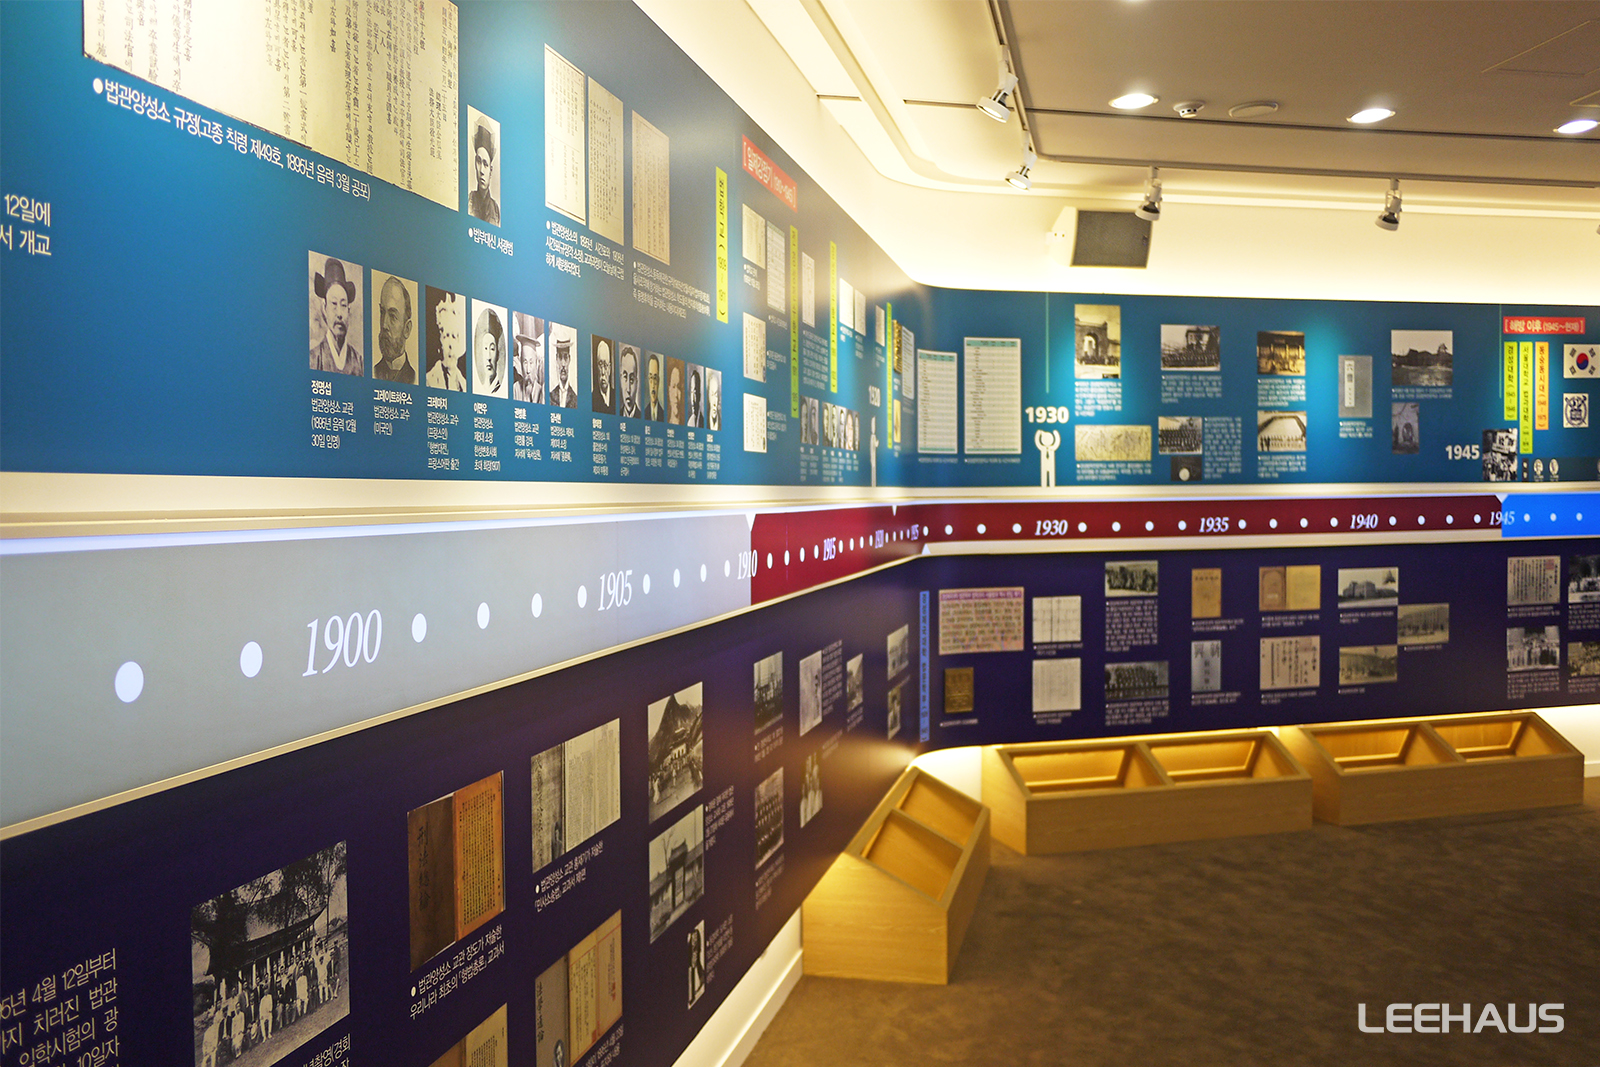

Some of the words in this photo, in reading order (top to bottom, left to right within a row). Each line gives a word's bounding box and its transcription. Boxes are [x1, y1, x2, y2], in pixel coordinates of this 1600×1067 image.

[105, 79, 170, 122] 법관양성소
[174, 106, 223, 144] 규정(고종
[226, 128, 248, 154] 칙령
[250, 138, 284, 168] 제49호,
[286, 154, 314, 180] 1895년
[316, 164, 334, 187] 음력
[336, 172, 350, 194] 3월
[352, 178, 371, 201] 공포)
[4, 194, 50, 227] 12일에
[19, 230, 52, 256] 개교
[474, 227, 496, 250] 법부대신
[311, 380, 332, 396] 정명섭
[311, 398, 341, 414] 법관양성소
[373, 405, 399, 420] 법관양성소
[400, 408, 410, 421] 교수
[1025, 406, 1069, 423] 1930
[332, 417, 344, 432] 음력
[311, 434, 325, 448] 30일
[1446, 444, 1480, 460] 1945
[1035, 519, 1068, 536] 1930
[1199, 516, 1229, 533] 1935
[1350, 514, 1378, 530] 1940
[1489, 510, 1515, 526] 1945
[822, 537, 836, 561] 1915
[737, 550, 758, 580] 1910
[598, 569, 632, 611] 1905
[302, 609, 382, 677] 1900
[418, 962, 452, 995] 법관양성소
[452, 954, 465, 970] 교관
[466, 940, 484, 961] 장도가
[485, 924, 502, 946] 저술한
[32, 974, 56, 1003] 4월
[62, 948, 116, 990] 12일부터
[409, 989, 437, 1020] 우리나라
[438, 976, 458, 999] 최초의
[487, 940, 505, 965] 교과서
[34, 995, 79, 1035] 치러진
[89, 977, 118, 1010] 법관
[104, 1006, 119, 1032] 광
[302, 1033, 350, 1067] 촬영(경회
